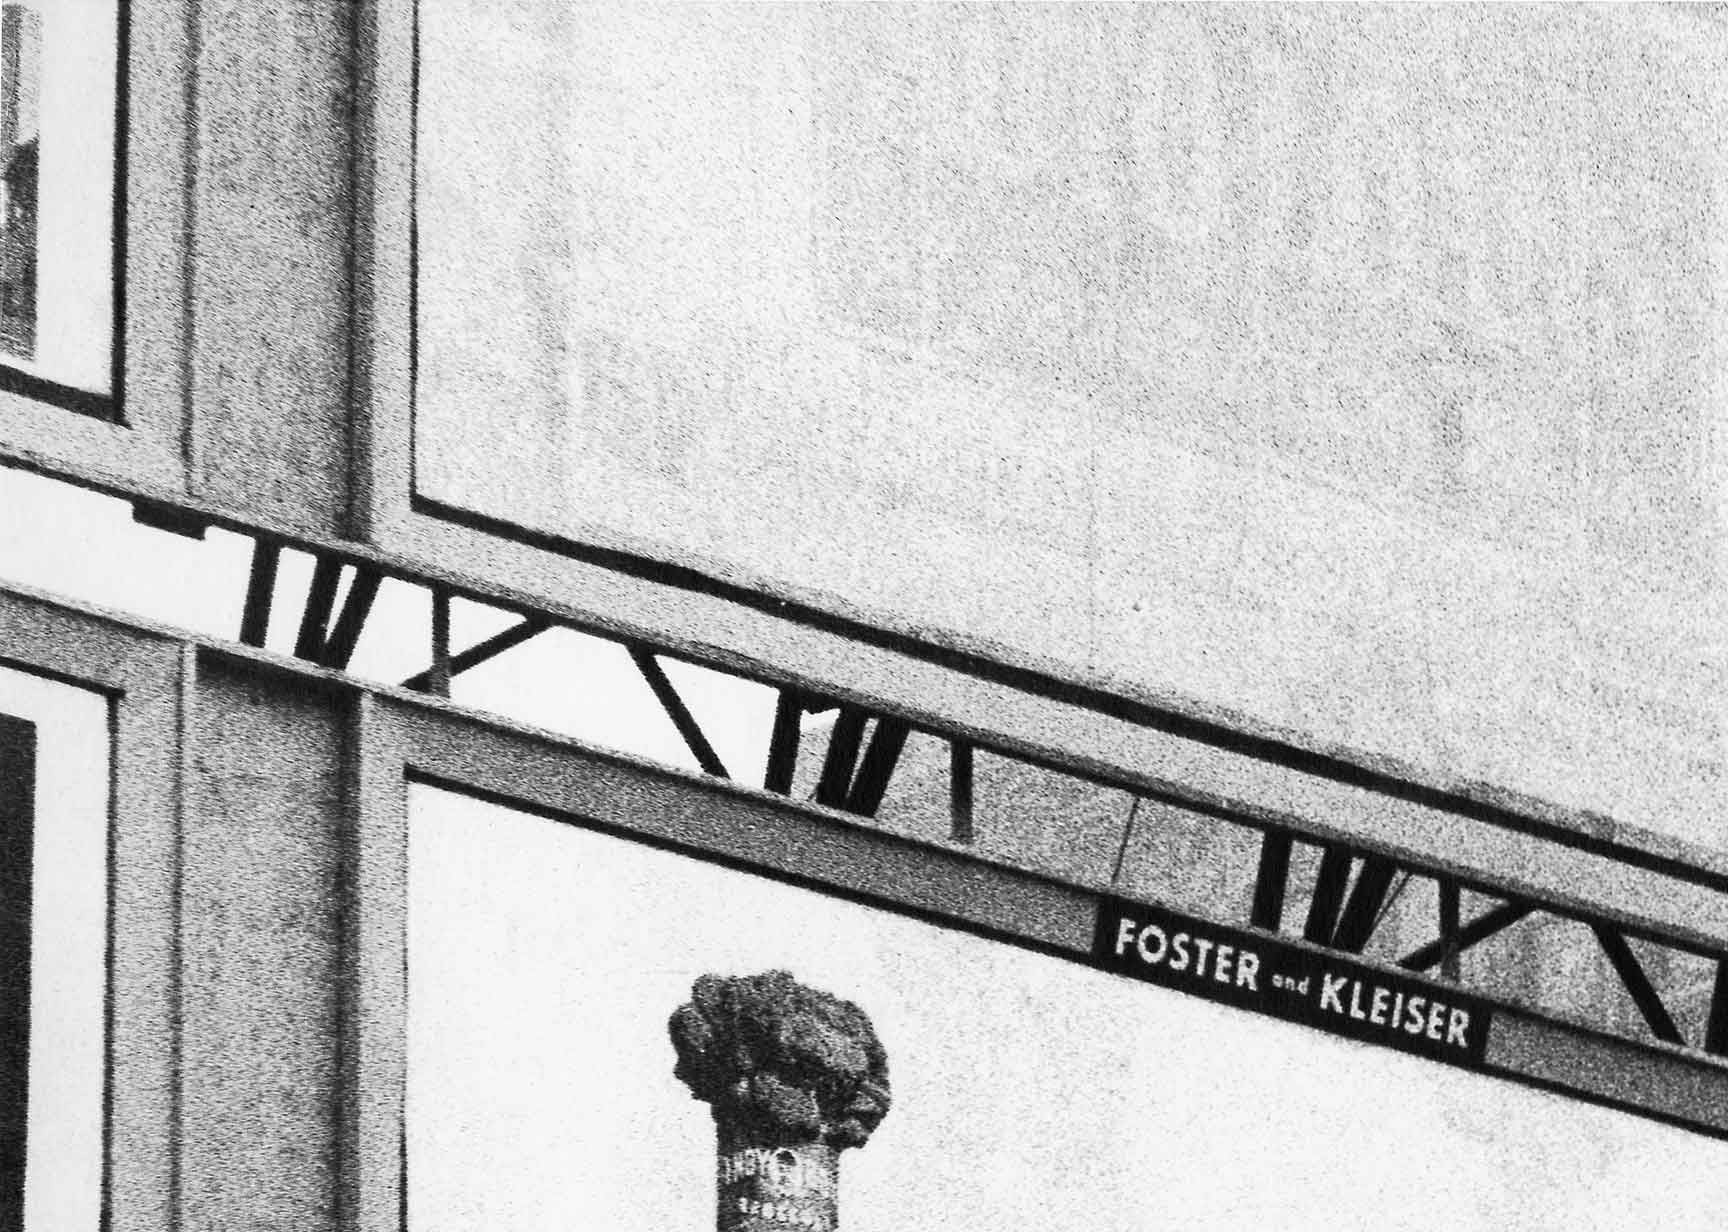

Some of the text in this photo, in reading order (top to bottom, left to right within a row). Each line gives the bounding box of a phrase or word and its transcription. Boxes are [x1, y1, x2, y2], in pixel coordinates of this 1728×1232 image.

[1115, 918, 1470, 1047] FOSTER and KLEISER
